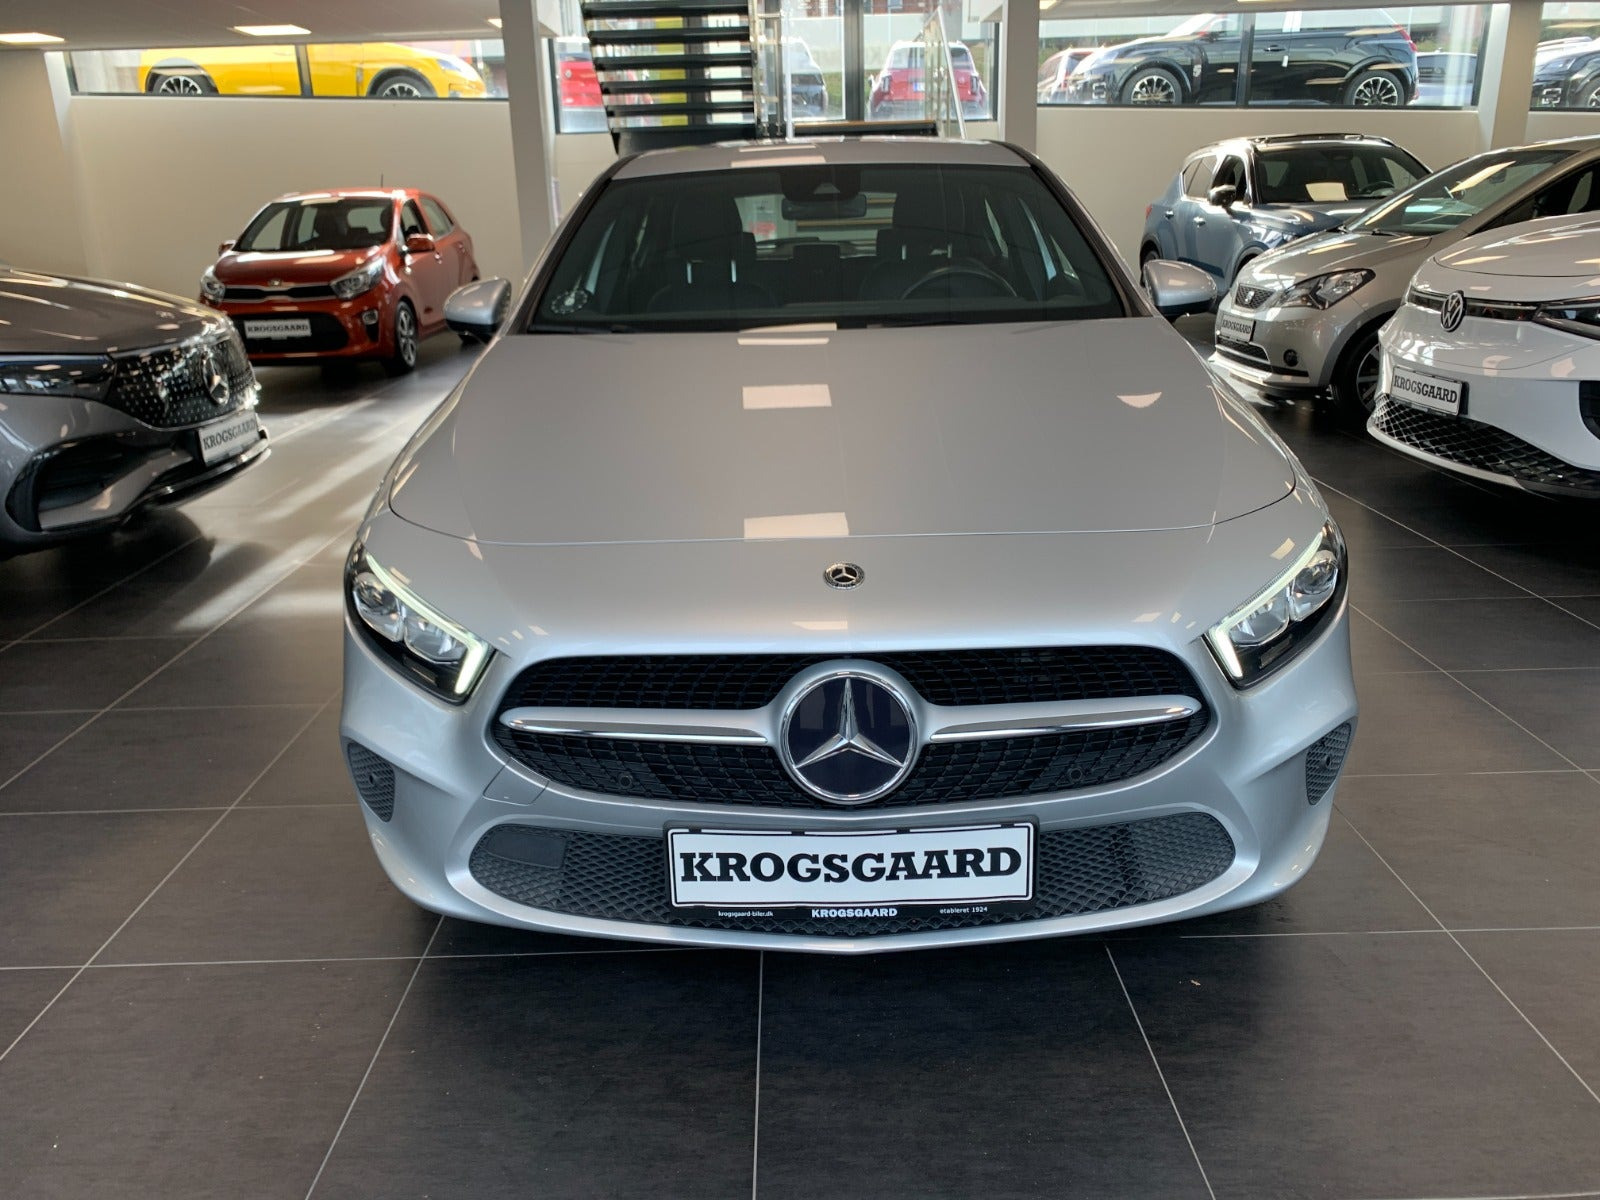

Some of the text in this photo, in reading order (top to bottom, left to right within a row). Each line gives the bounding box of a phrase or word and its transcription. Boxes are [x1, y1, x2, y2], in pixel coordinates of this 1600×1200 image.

[247, 324, 309, 332] KROGSGAARD
[1394, 375, 1458, 403] KROGSGAARD
[202, 419, 257, 450] KROGSGAARD
[679, 846, 1022, 883] KROGSGAARD
[811, 908, 898, 918] KROGSGAARD
